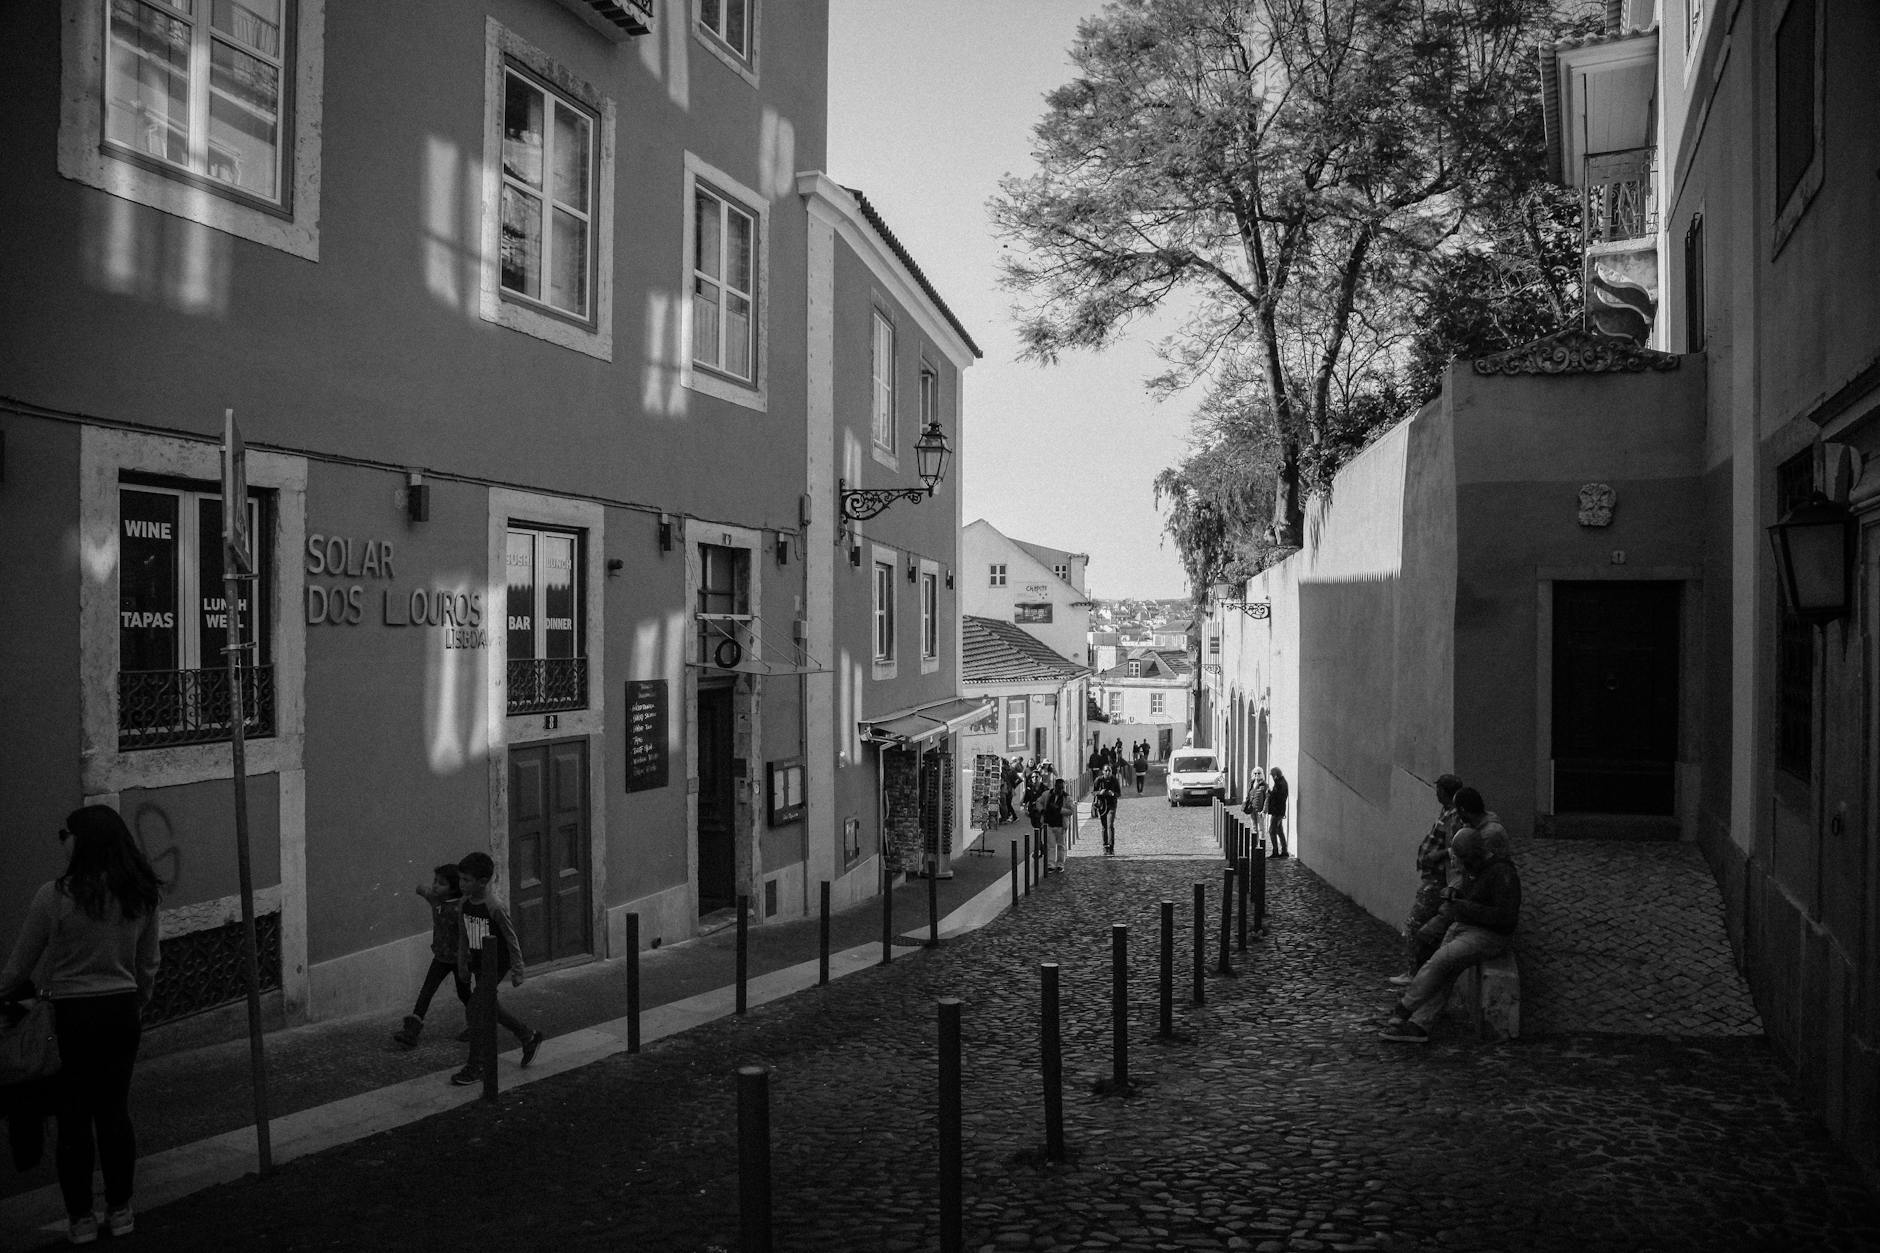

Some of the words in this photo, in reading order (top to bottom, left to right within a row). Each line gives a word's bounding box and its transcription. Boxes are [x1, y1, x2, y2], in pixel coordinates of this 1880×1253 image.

[124, 519, 172, 540] WINE
[307, 533, 396, 578] SOLAR
[506, 553, 532, 567] SUSHI
[203, 597, 248, 611] LUNH
[307, 584, 364, 626] DOS
[383, 587, 482, 628] LOUROS
[121, 611, 174, 628] TAPAS
[205, 614, 245, 629] WEL
[508, 615, 531, 630] BAR
[545, 617, 573, 631] DINNER
[445, 628, 489, 650] LISBOA
[549, 715, 554, 729] 8
